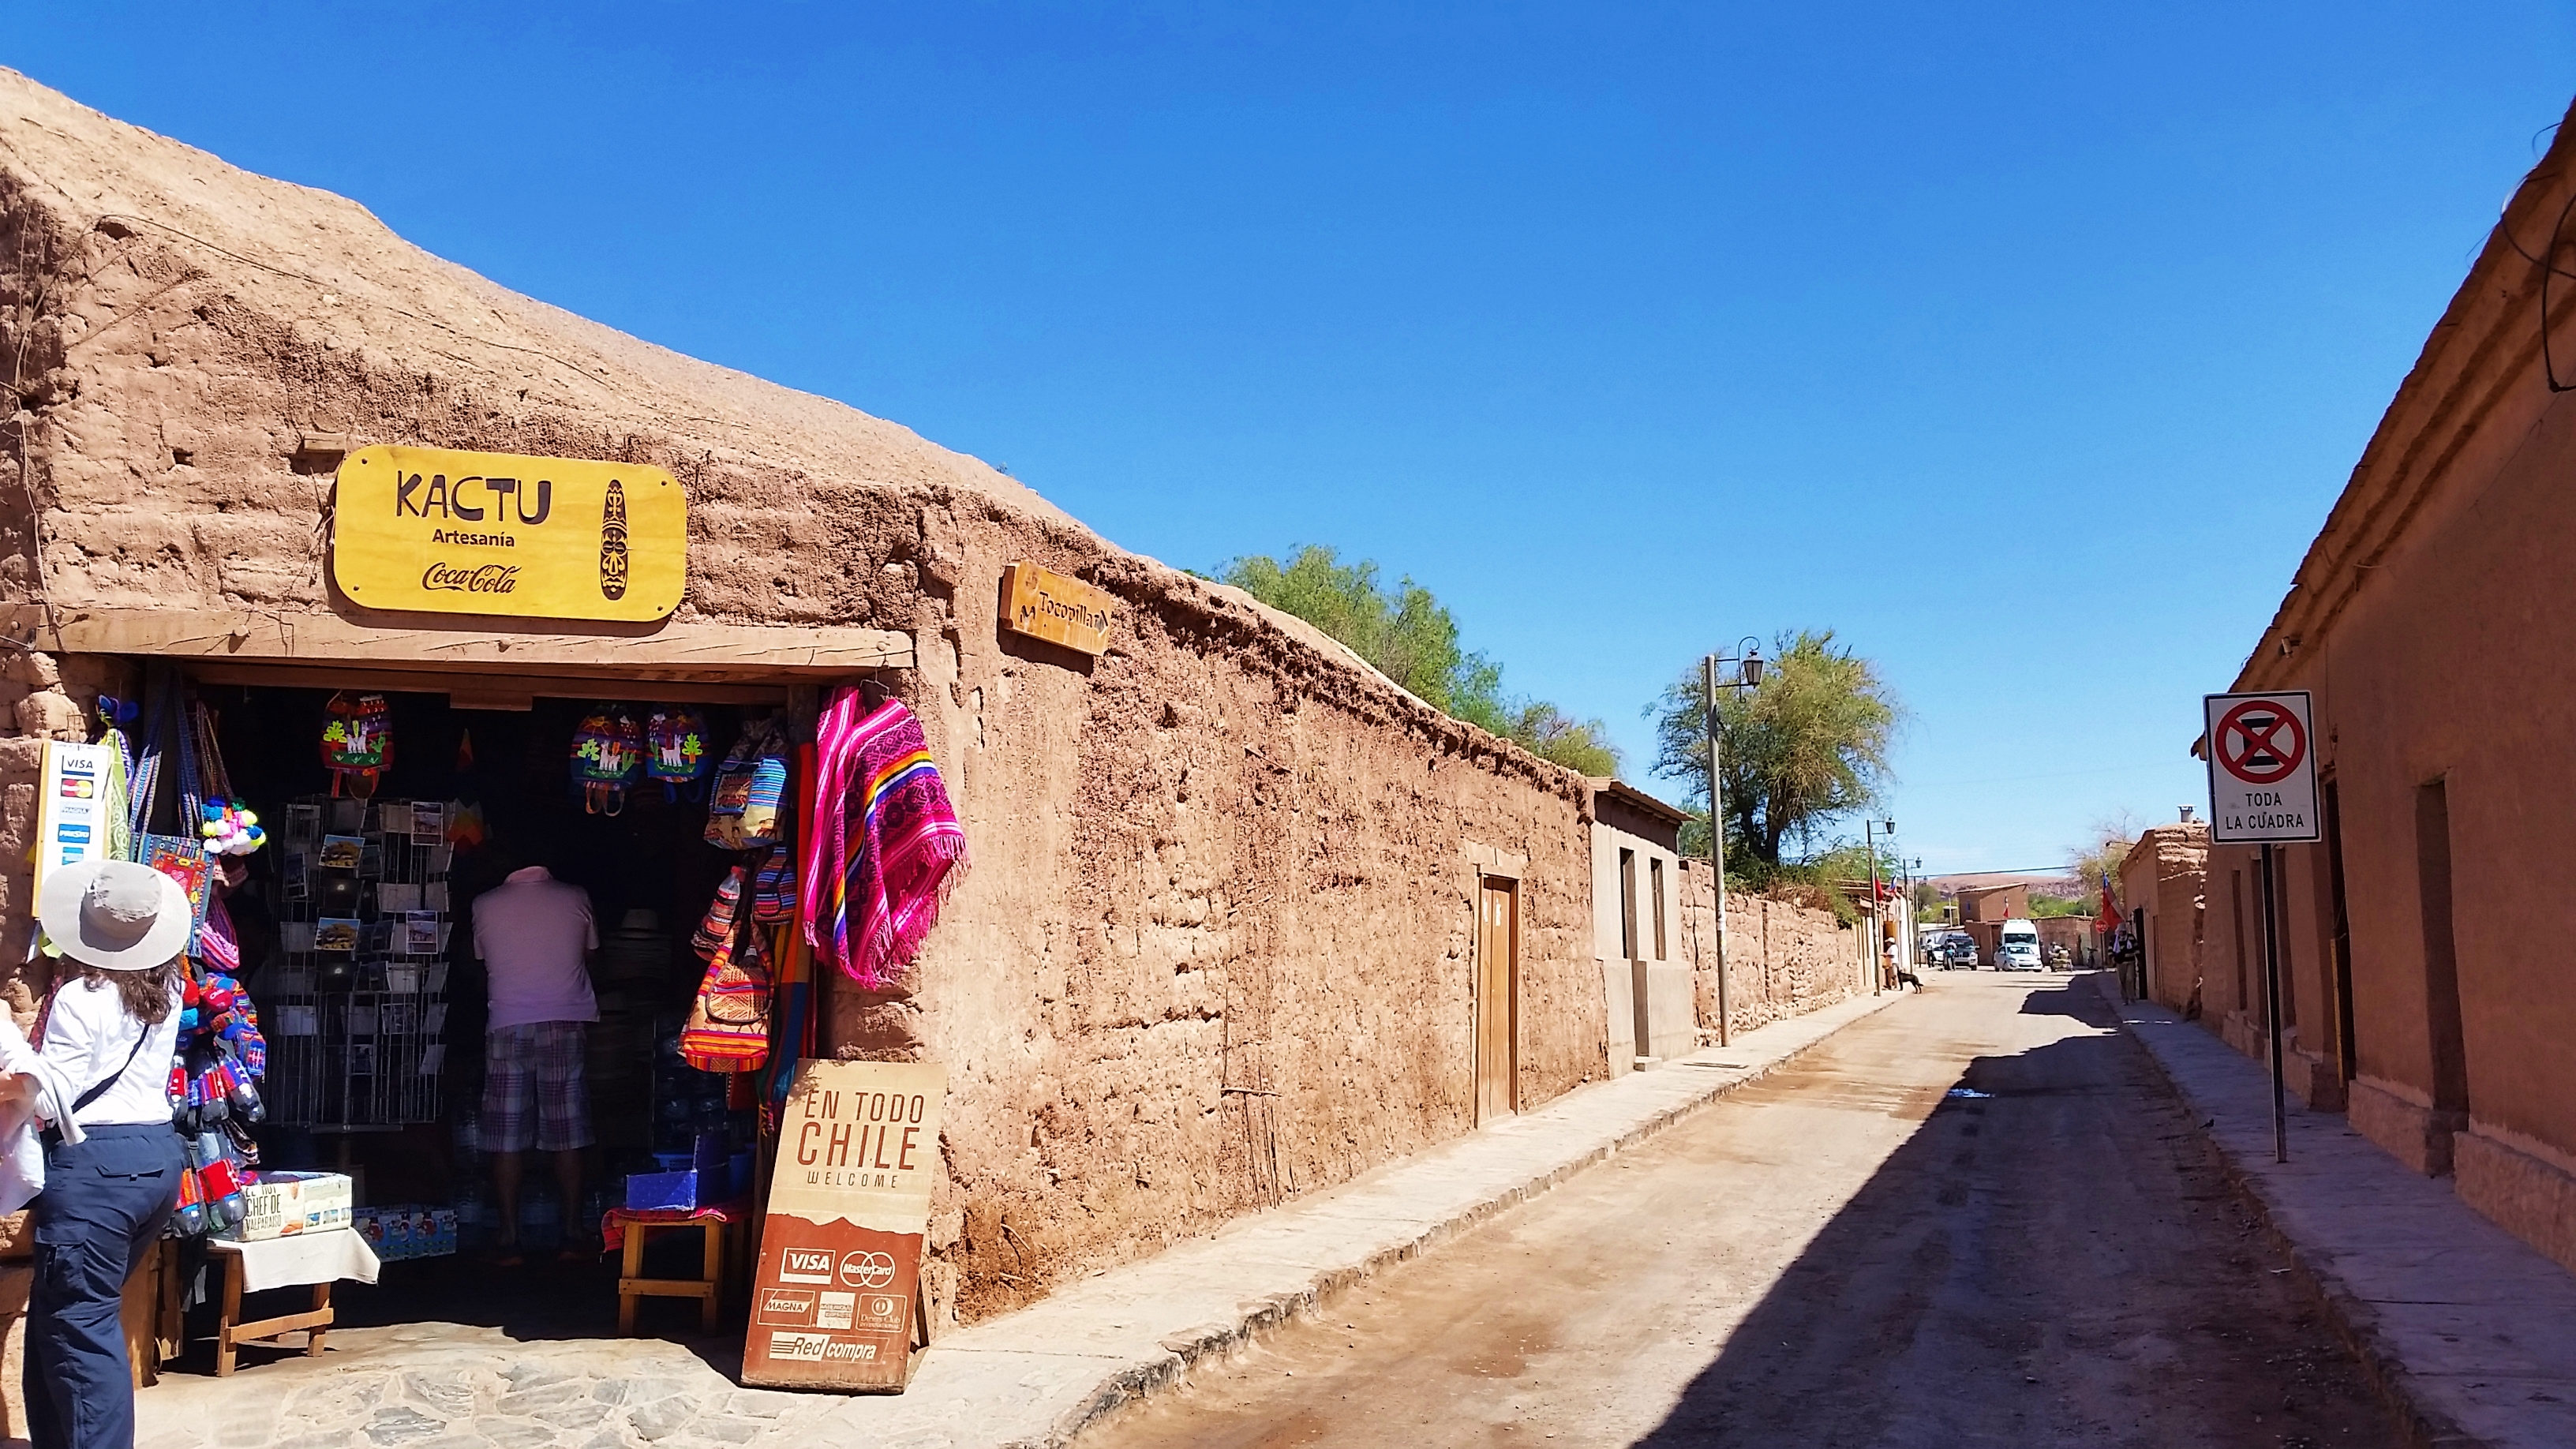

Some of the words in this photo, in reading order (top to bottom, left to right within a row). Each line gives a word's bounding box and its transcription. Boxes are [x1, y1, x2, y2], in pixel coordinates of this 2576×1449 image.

[396, 470, 551, 525] KACTU
[432, 529, 515, 547] Artesanía
[422, 562, 522, 593] Coca-Cola
[67, 759, 93, 769] VISA
[2245, 792, 2282, 807] TODA
[2226, 816, 2243, 829] LA
[2248, 814, 2305, 829] CUADRA
[804, 1090, 840, 1119] EN
[856, 1091, 924, 1123] TODO
[797, 1121, 920, 1170] CHILE
[807, 1171, 898, 1188] WELCOME
[246, 1196, 268, 1217] CHEF
[271, 1194, 281, 1214] DE
[789, 1252, 829, 1271] VISA
[843, 1264, 893, 1276] MasterCard
[766, 1302, 803, 1312] MAGNA
[792, 1337, 826, 1355] Red
[826, 1342, 877, 1363] compra
